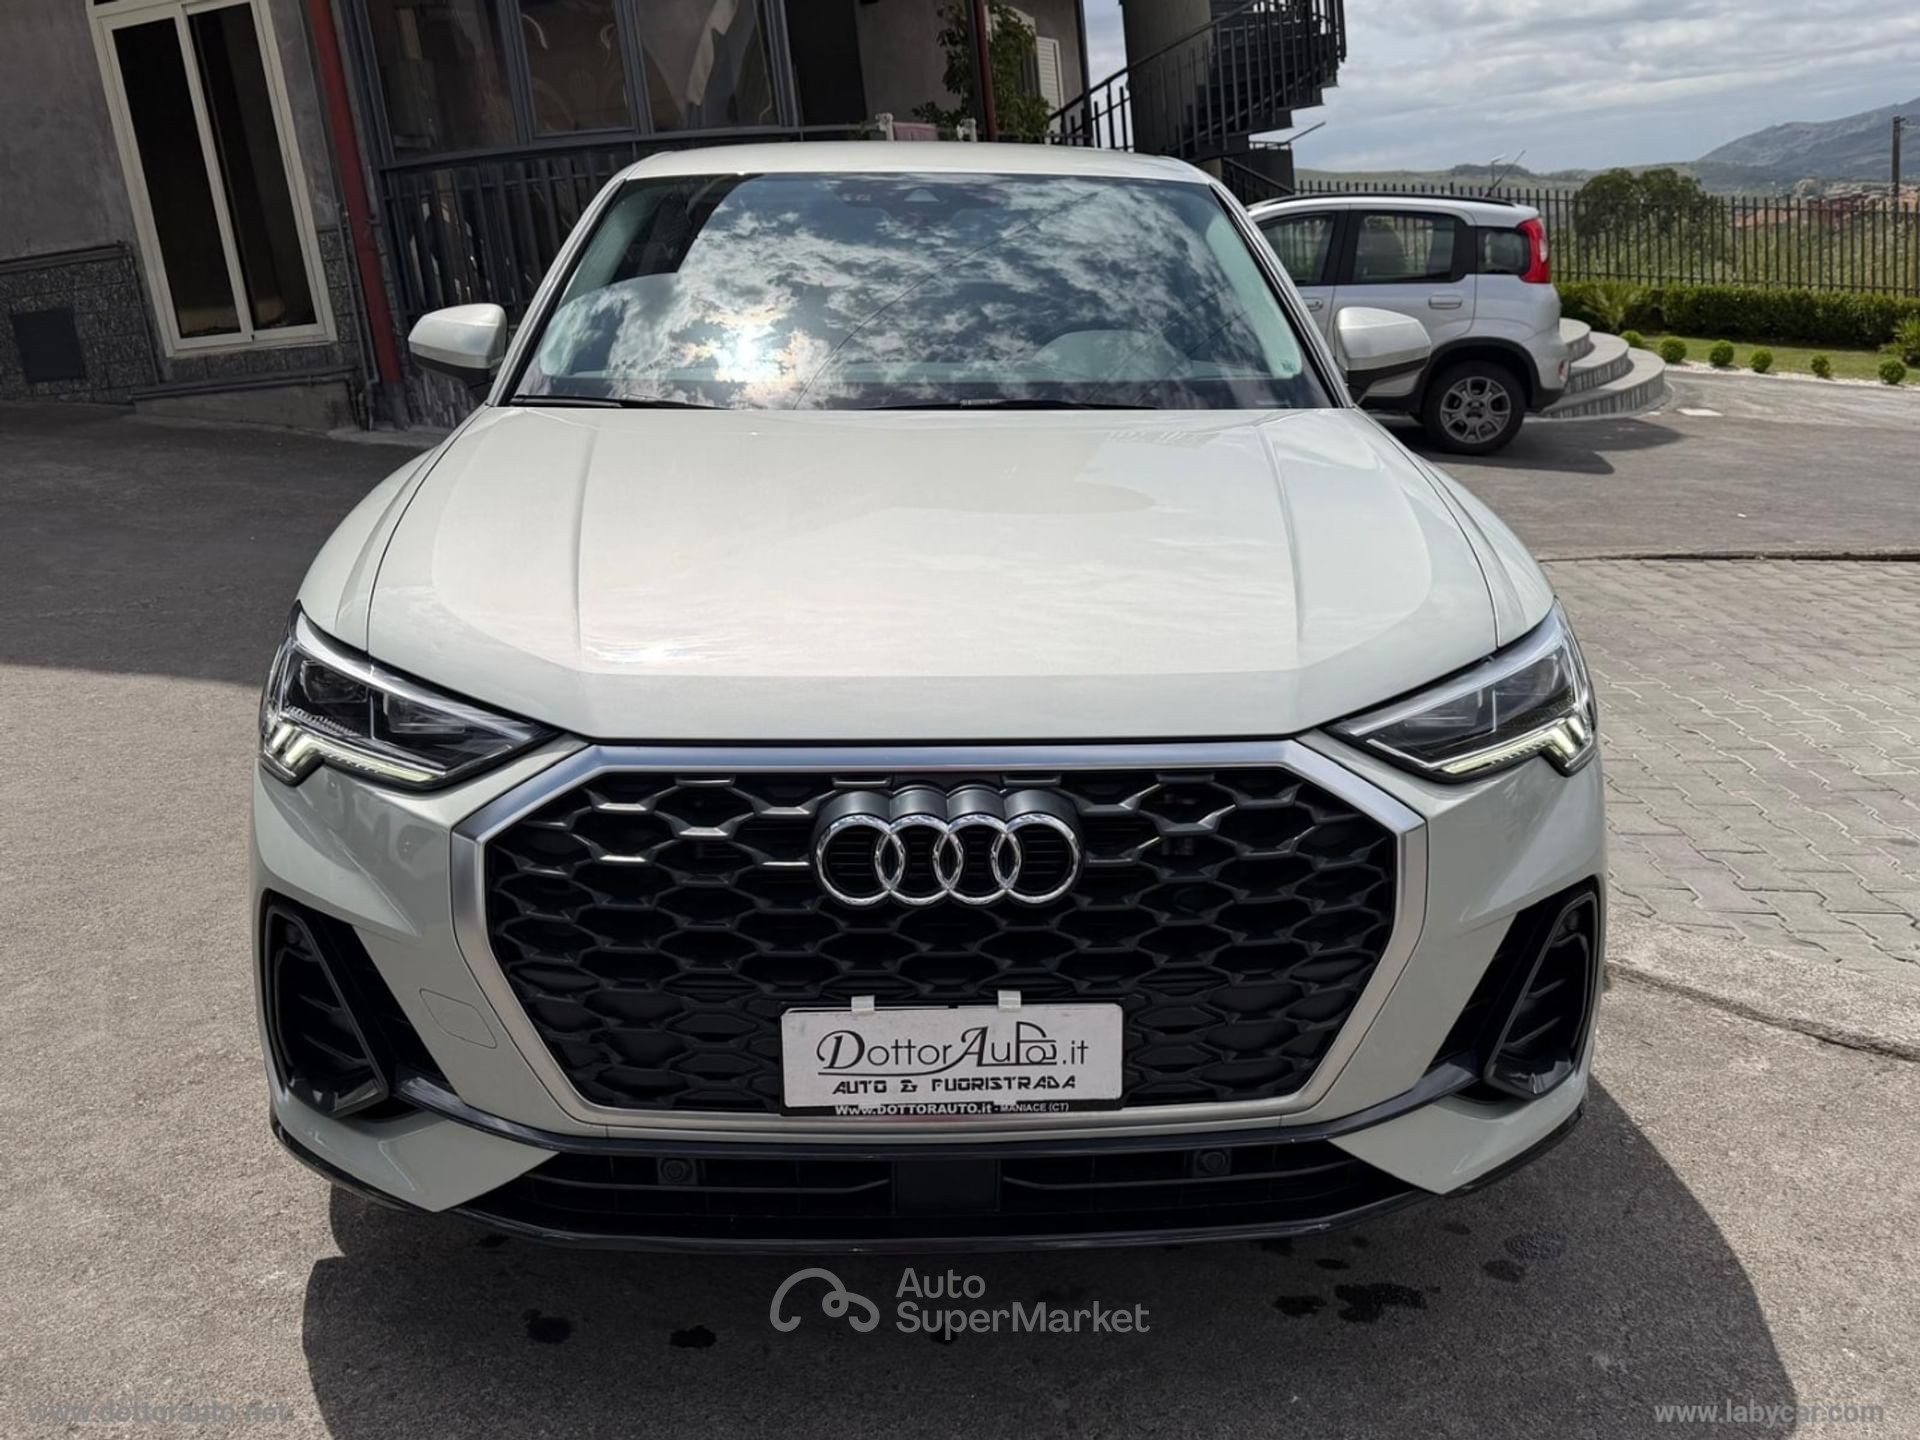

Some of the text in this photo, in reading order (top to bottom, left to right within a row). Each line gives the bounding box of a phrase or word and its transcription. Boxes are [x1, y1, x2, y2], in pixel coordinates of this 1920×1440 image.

[832, 1075, 1076, 1095] AUTO & FUORISTRADA
[1000, 1103, 1047, 1113] MANIACE
[1049, 1102, 1070, 1113] (CT)
